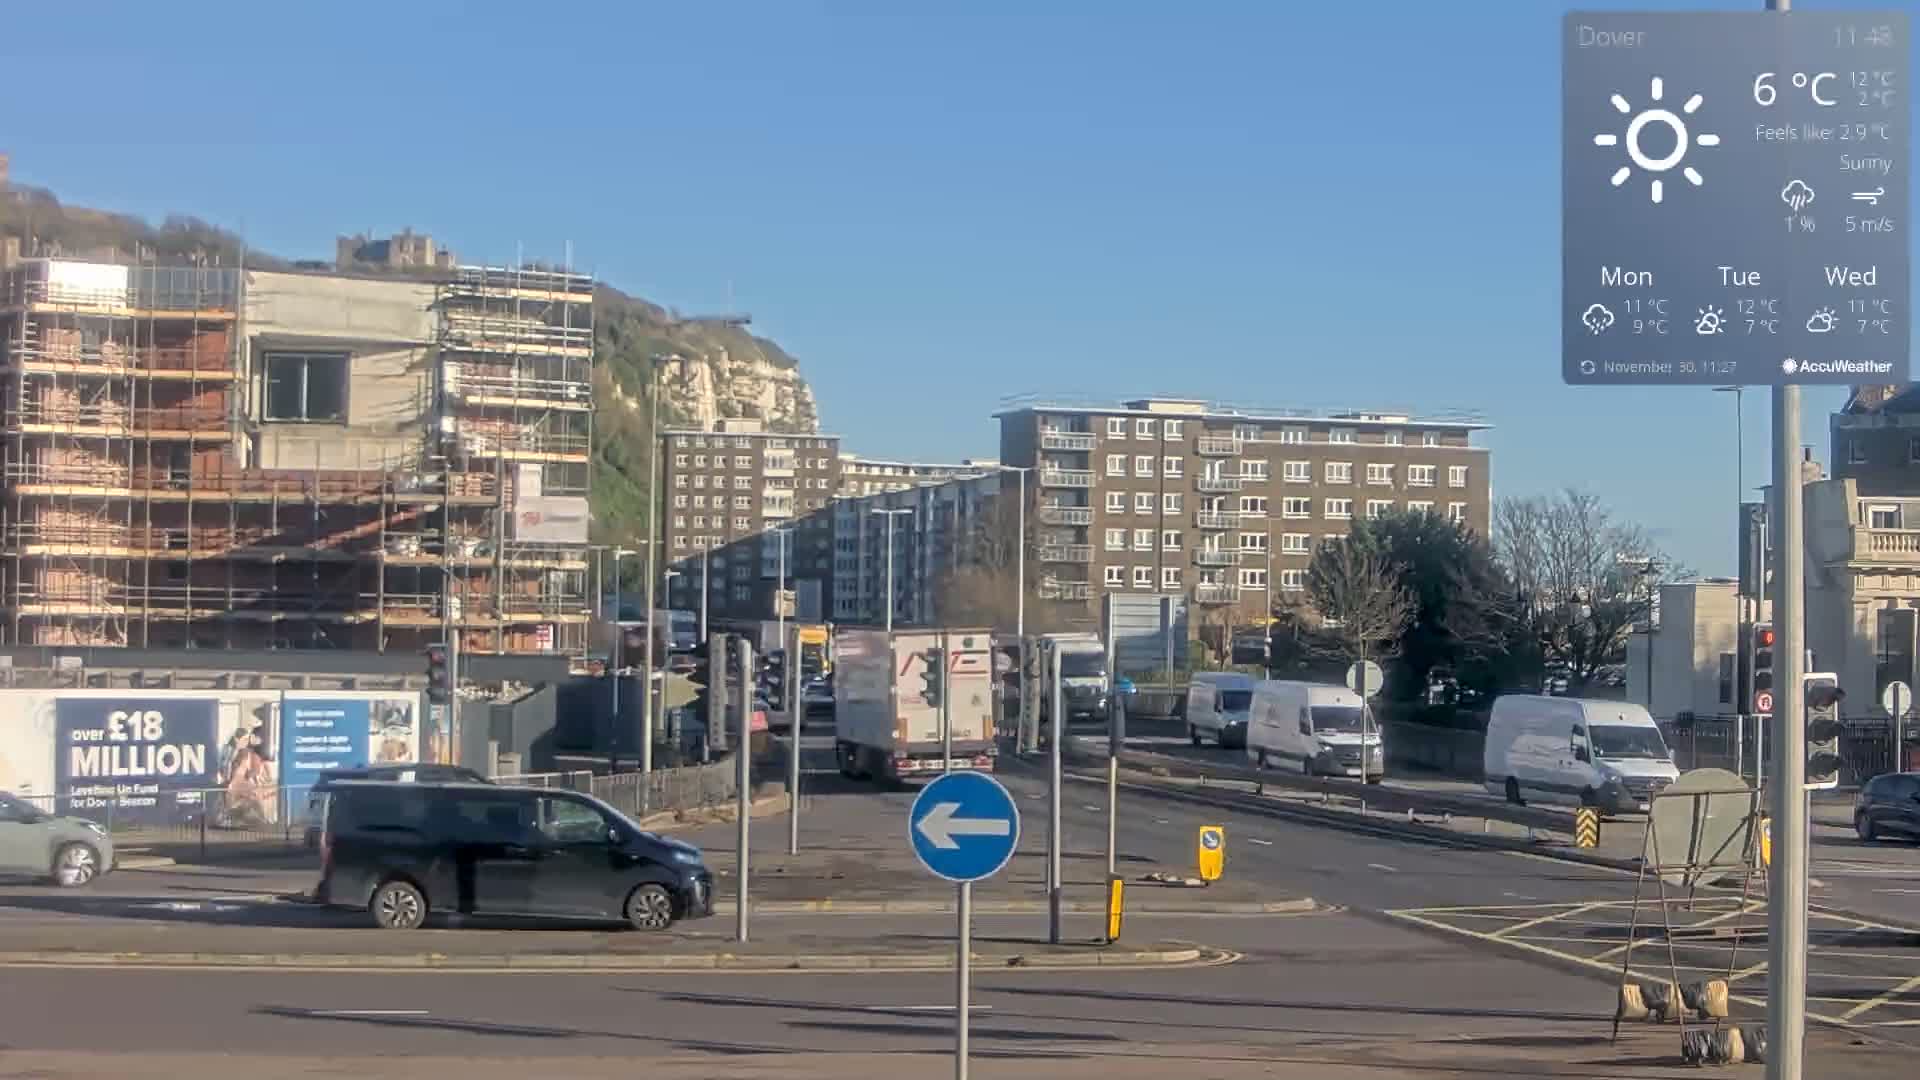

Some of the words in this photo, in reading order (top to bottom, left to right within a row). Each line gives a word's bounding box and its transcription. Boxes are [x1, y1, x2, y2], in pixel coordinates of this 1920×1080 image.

[71, 728, 106, 741] over
[109, 710, 164, 742] £18
[71, 744, 206, 777] MILLION
